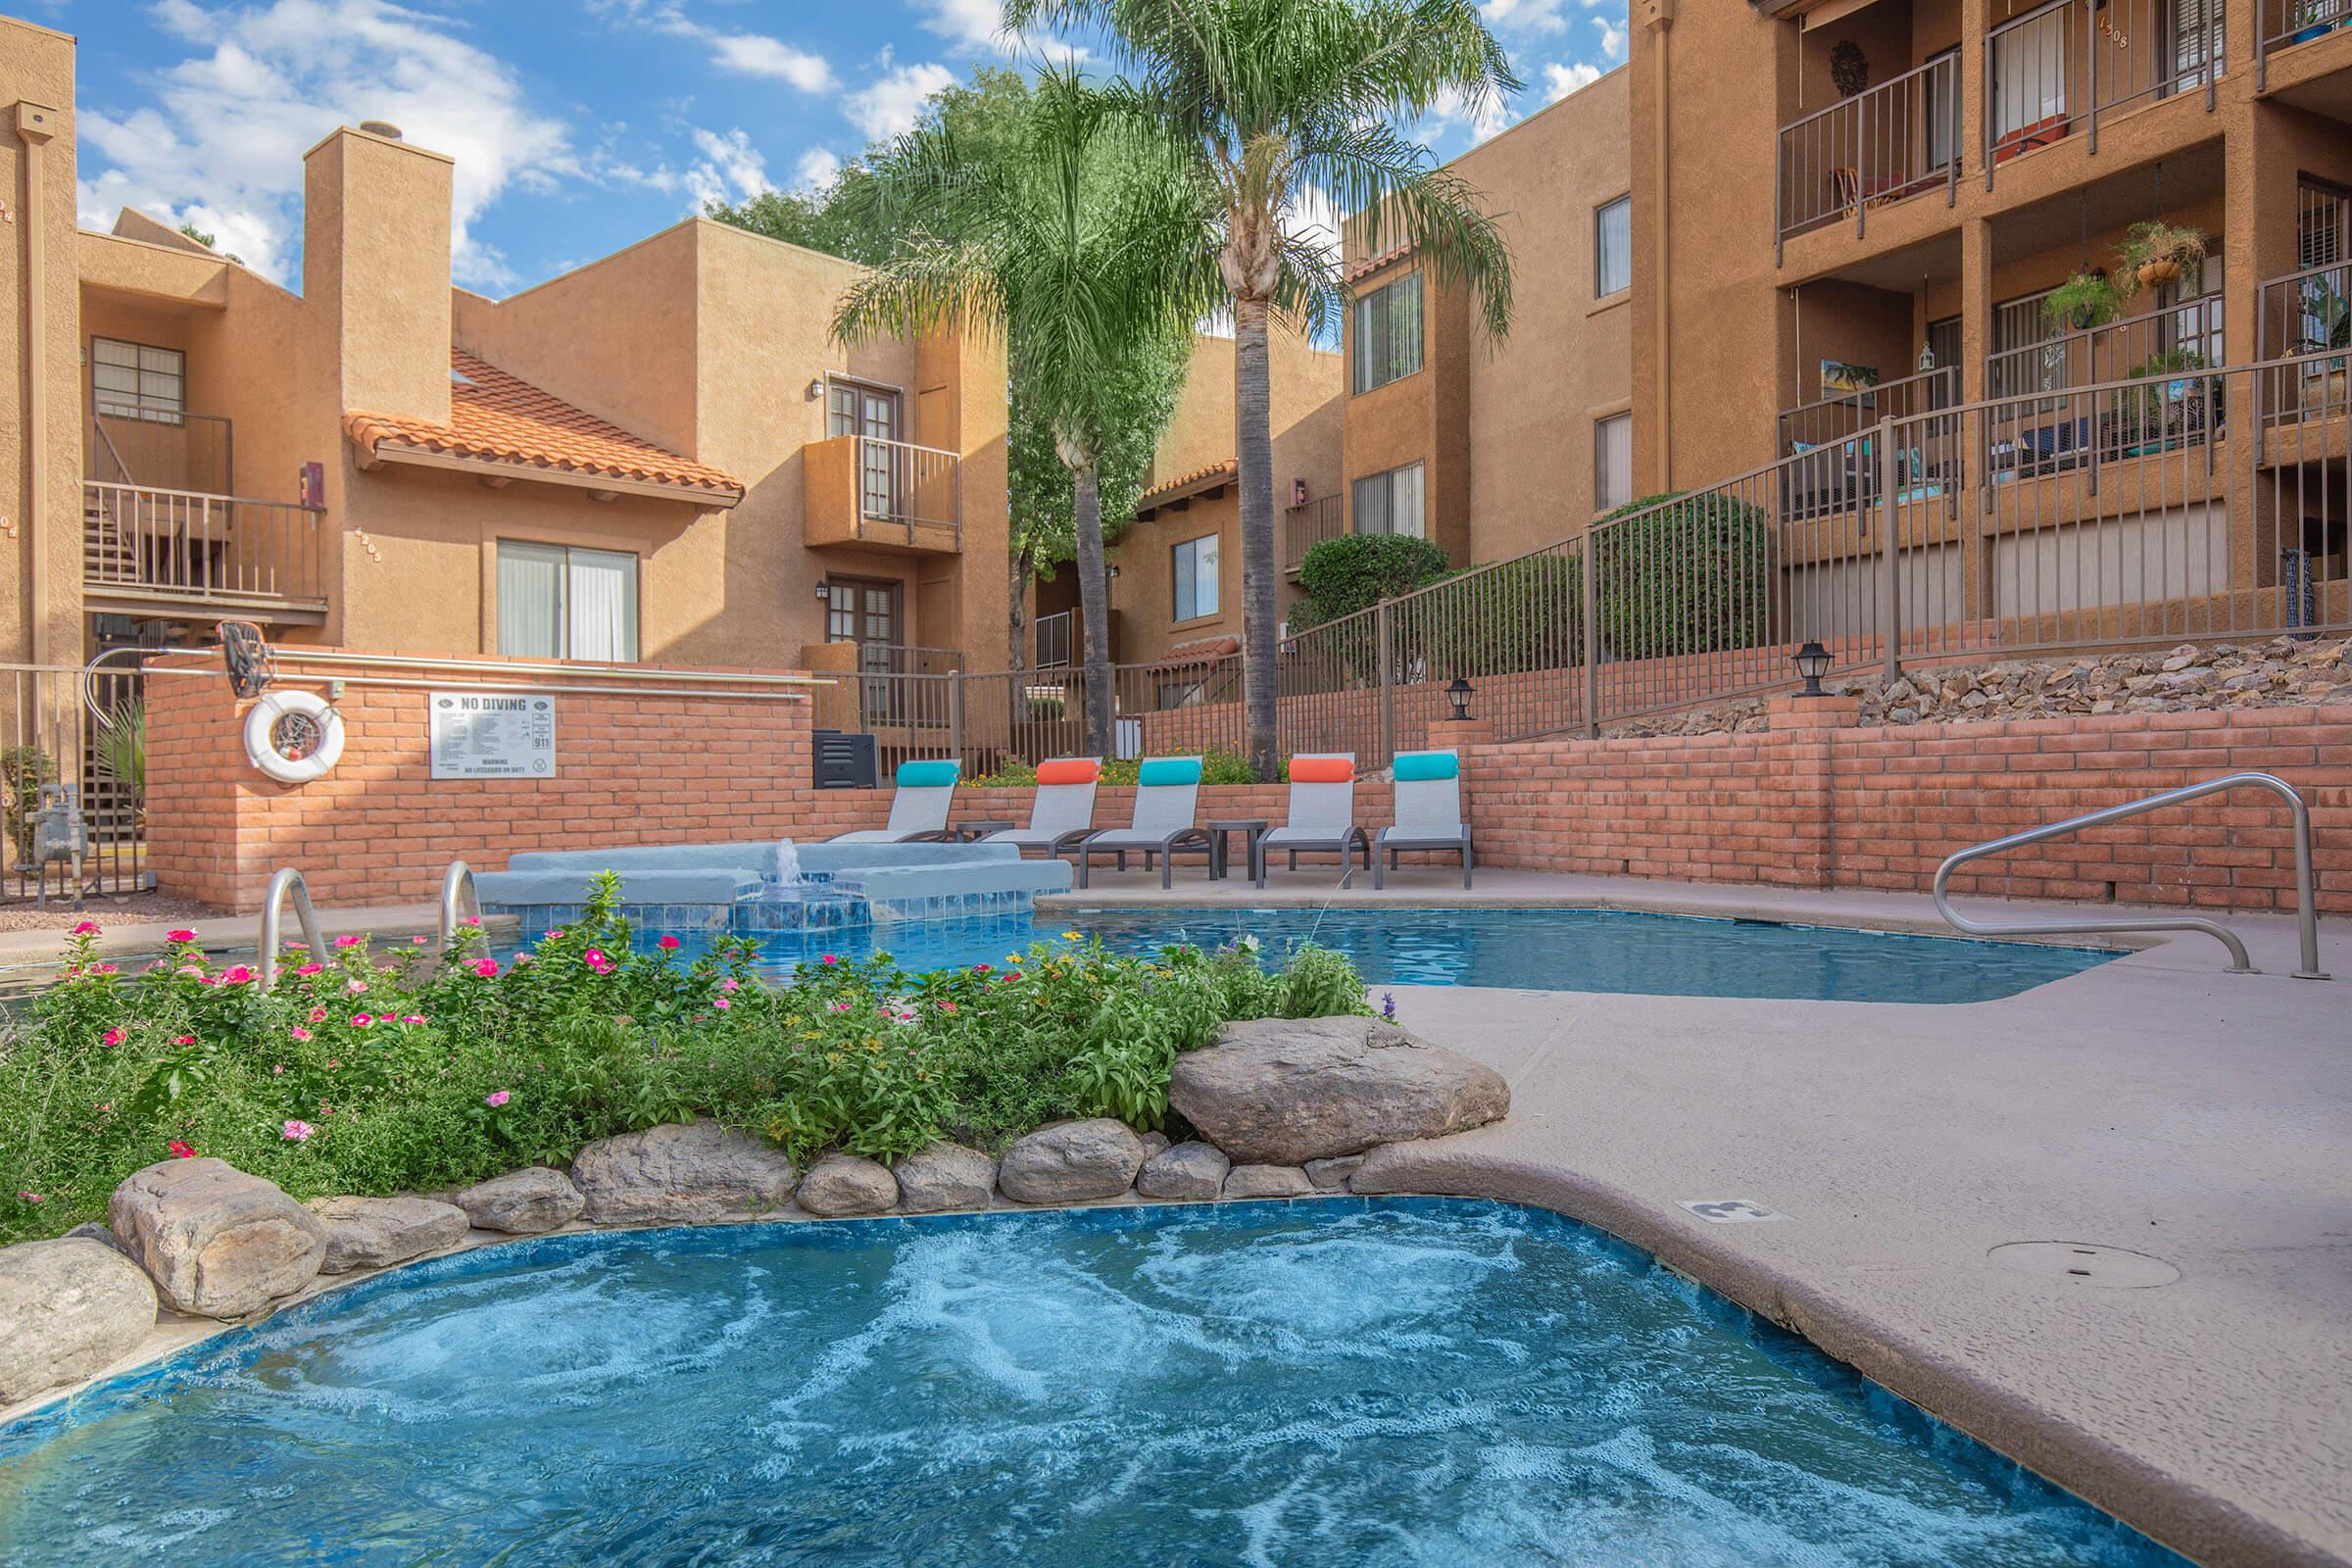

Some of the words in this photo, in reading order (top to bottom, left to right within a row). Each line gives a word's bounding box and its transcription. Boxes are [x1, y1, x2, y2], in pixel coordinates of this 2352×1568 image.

[462, 697, 478, 710] NO
[482, 698, 526, 710] DIVING
[534, 737, 549, 748] 911
